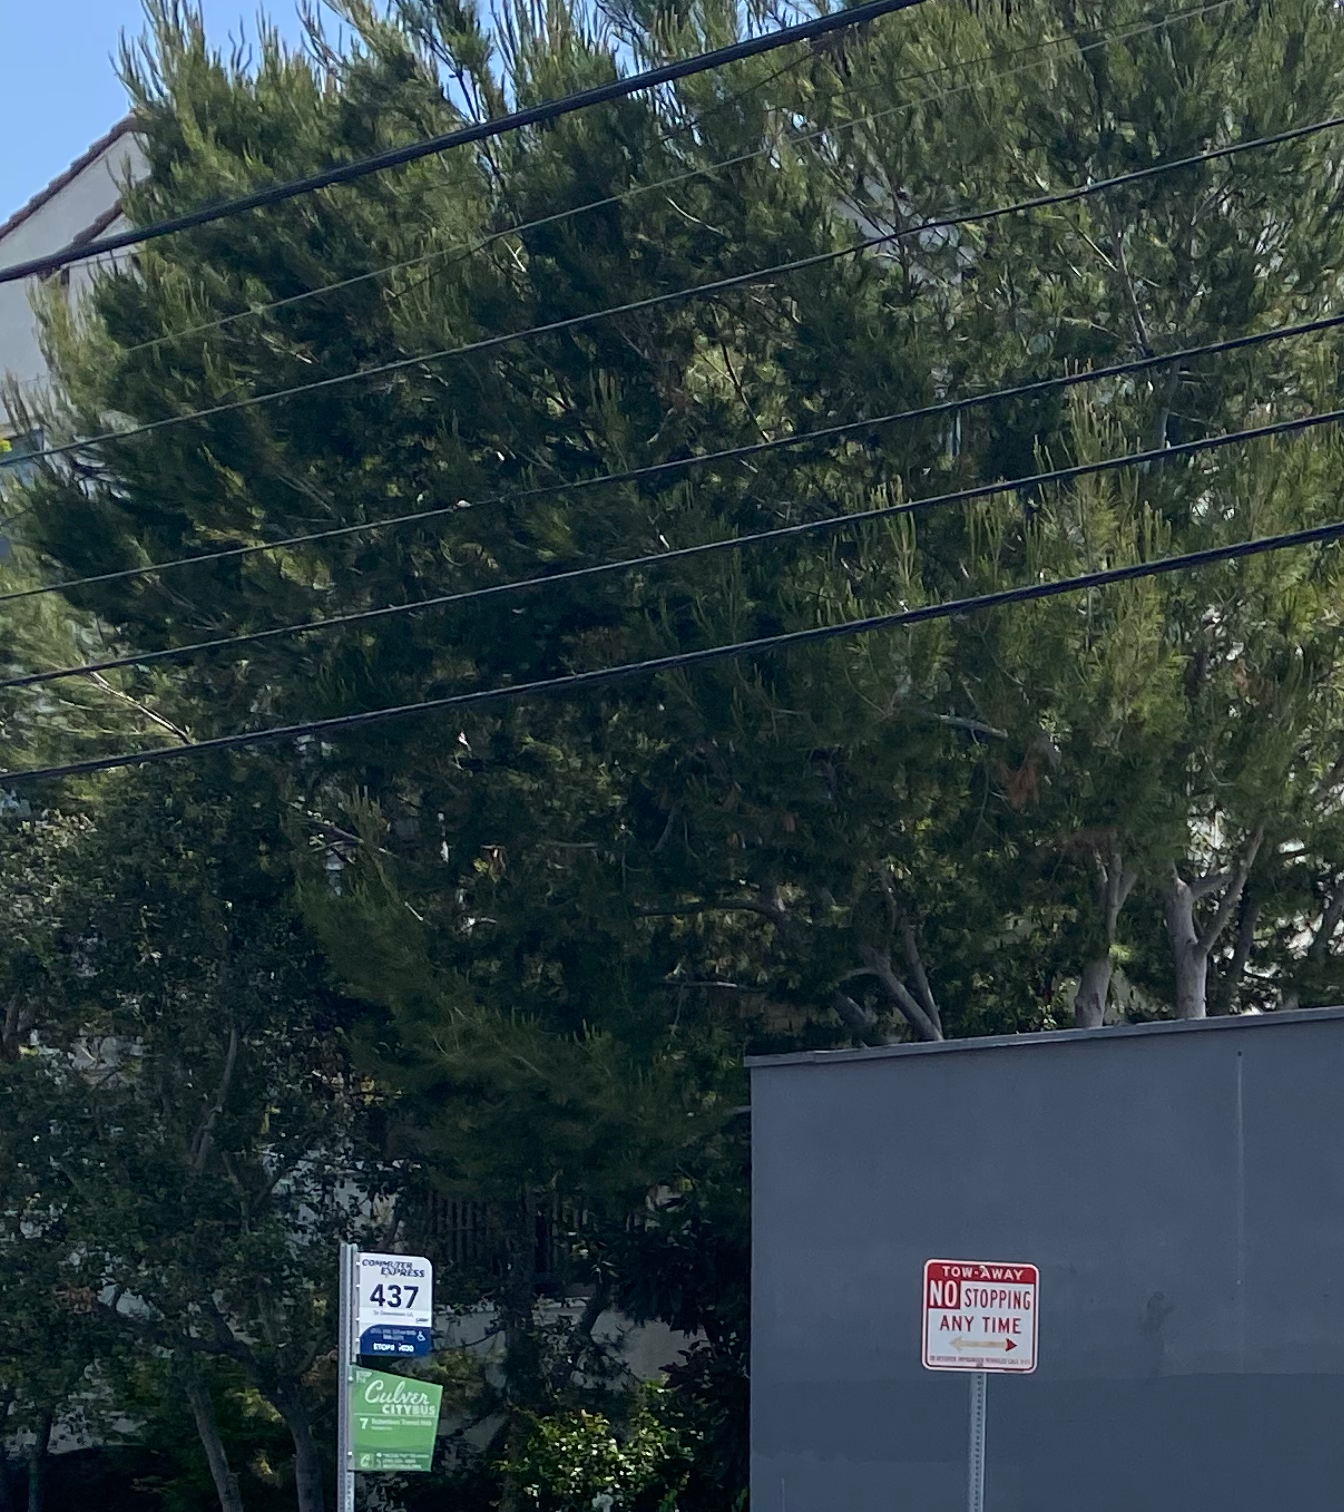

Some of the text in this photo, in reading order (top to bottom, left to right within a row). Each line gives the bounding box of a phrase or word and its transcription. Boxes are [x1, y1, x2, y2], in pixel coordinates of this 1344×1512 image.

[362, 1259, 413, 1269] COMMUTER
[380, 1267, 425, 1278] EXPRESS
[942, 1265, 1024, 1281] TOW-AWAY
[369, 1283, 419, 1309] 437
[929, 1280, 1031, 1311] NO STOPPING
[939, 1315, 1022, 1334] ANY TIME
[364, 1379, 430, 1405] Culver
[382, 1403, 436, 1415] CITYBUS
[359, 1417, 369, 1430] 7
